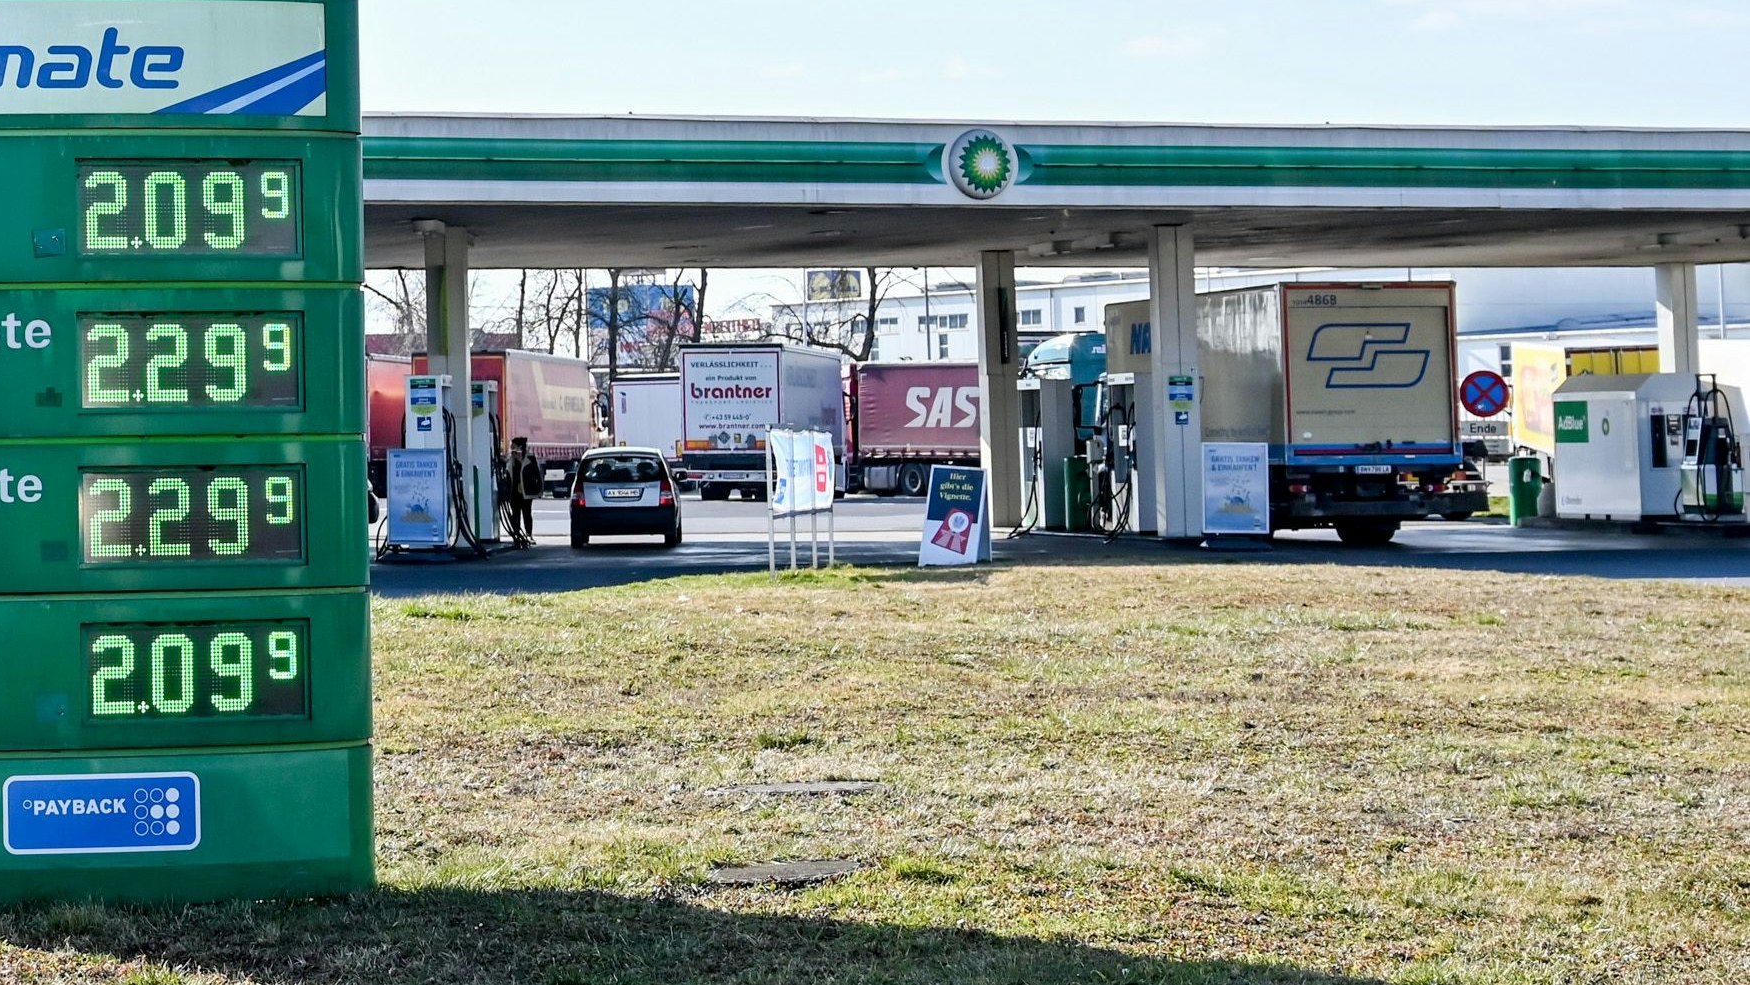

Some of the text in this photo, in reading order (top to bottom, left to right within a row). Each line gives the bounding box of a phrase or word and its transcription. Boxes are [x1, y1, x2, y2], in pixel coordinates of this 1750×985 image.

[691, 382, 772, 399] brantner
[904, 386, 979, 428] SAS
[1470, 423, 1497, 434] Ende
[950, 472, 966, 480] Hier
[939, 492, 972, 501] Vignette.
[34, 799, 127, 816] PAYBACK
